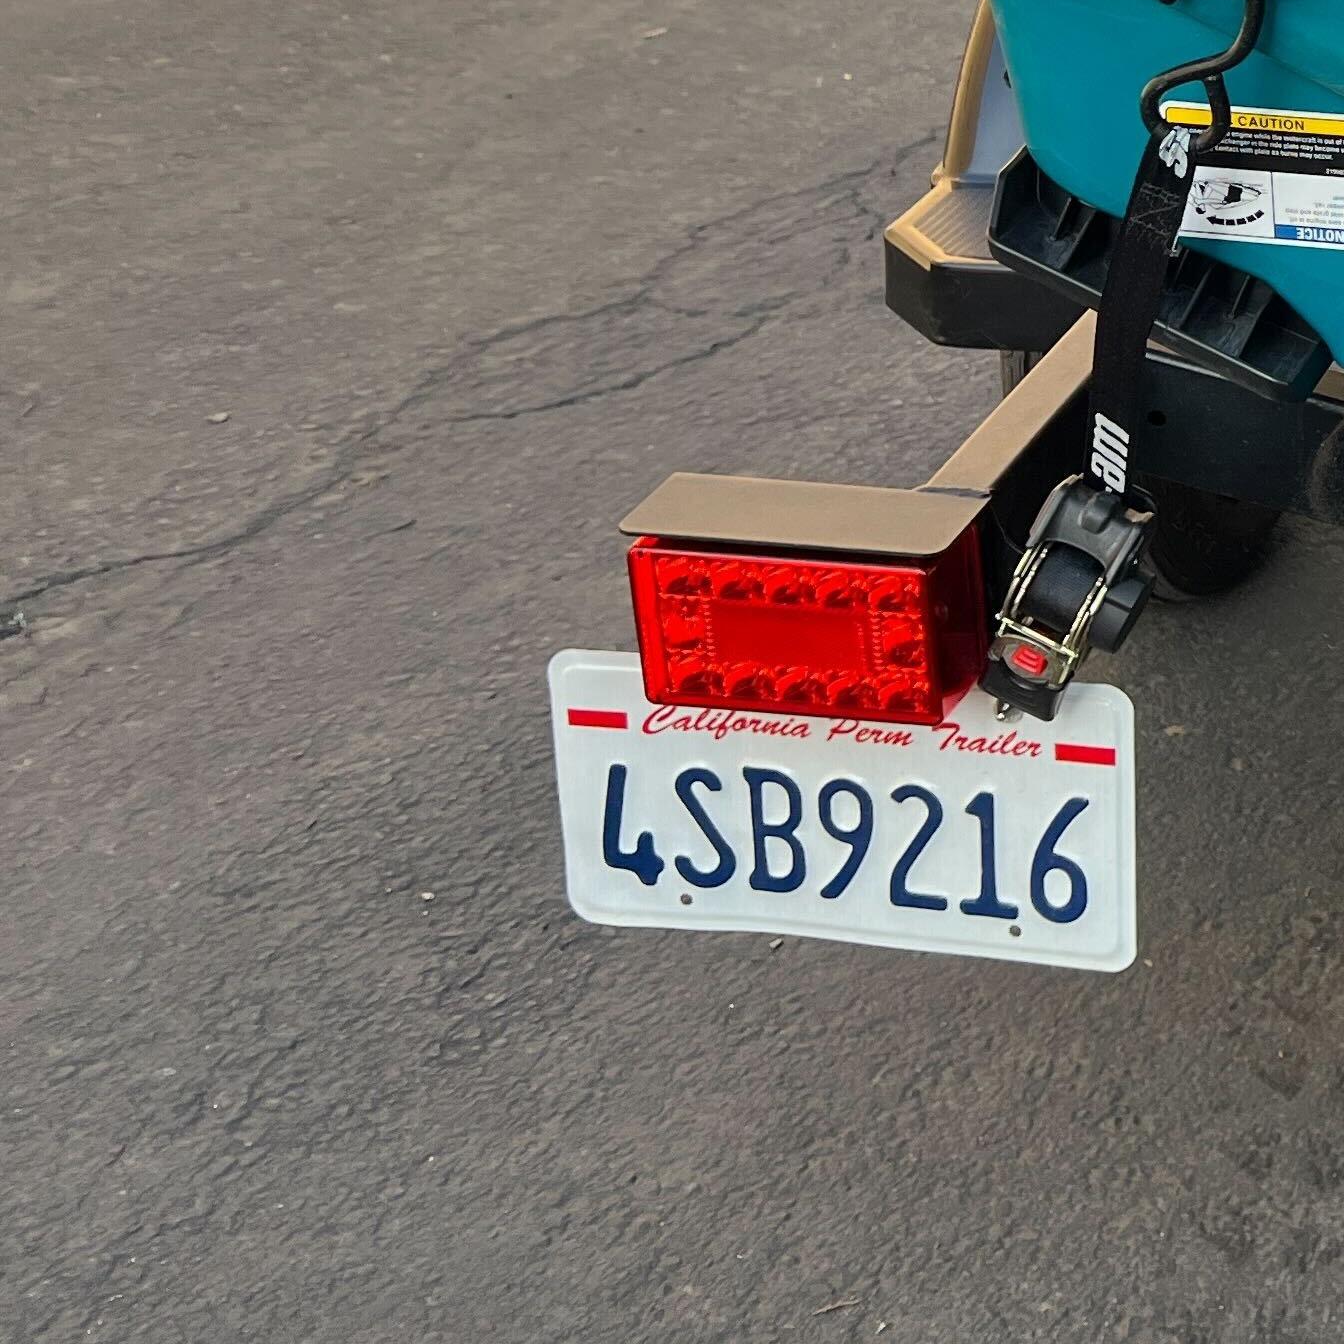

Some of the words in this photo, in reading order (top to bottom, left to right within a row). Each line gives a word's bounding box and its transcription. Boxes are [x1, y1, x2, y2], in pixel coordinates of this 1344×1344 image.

[1237, 115, 1305, 131] CAUTION
[642, 705, 812, 739] California
[826, 718, 913, 747] Perm
[934, 723, 1042, 758] Trailer
[602, 763, 1090, 925] 4SB9216
